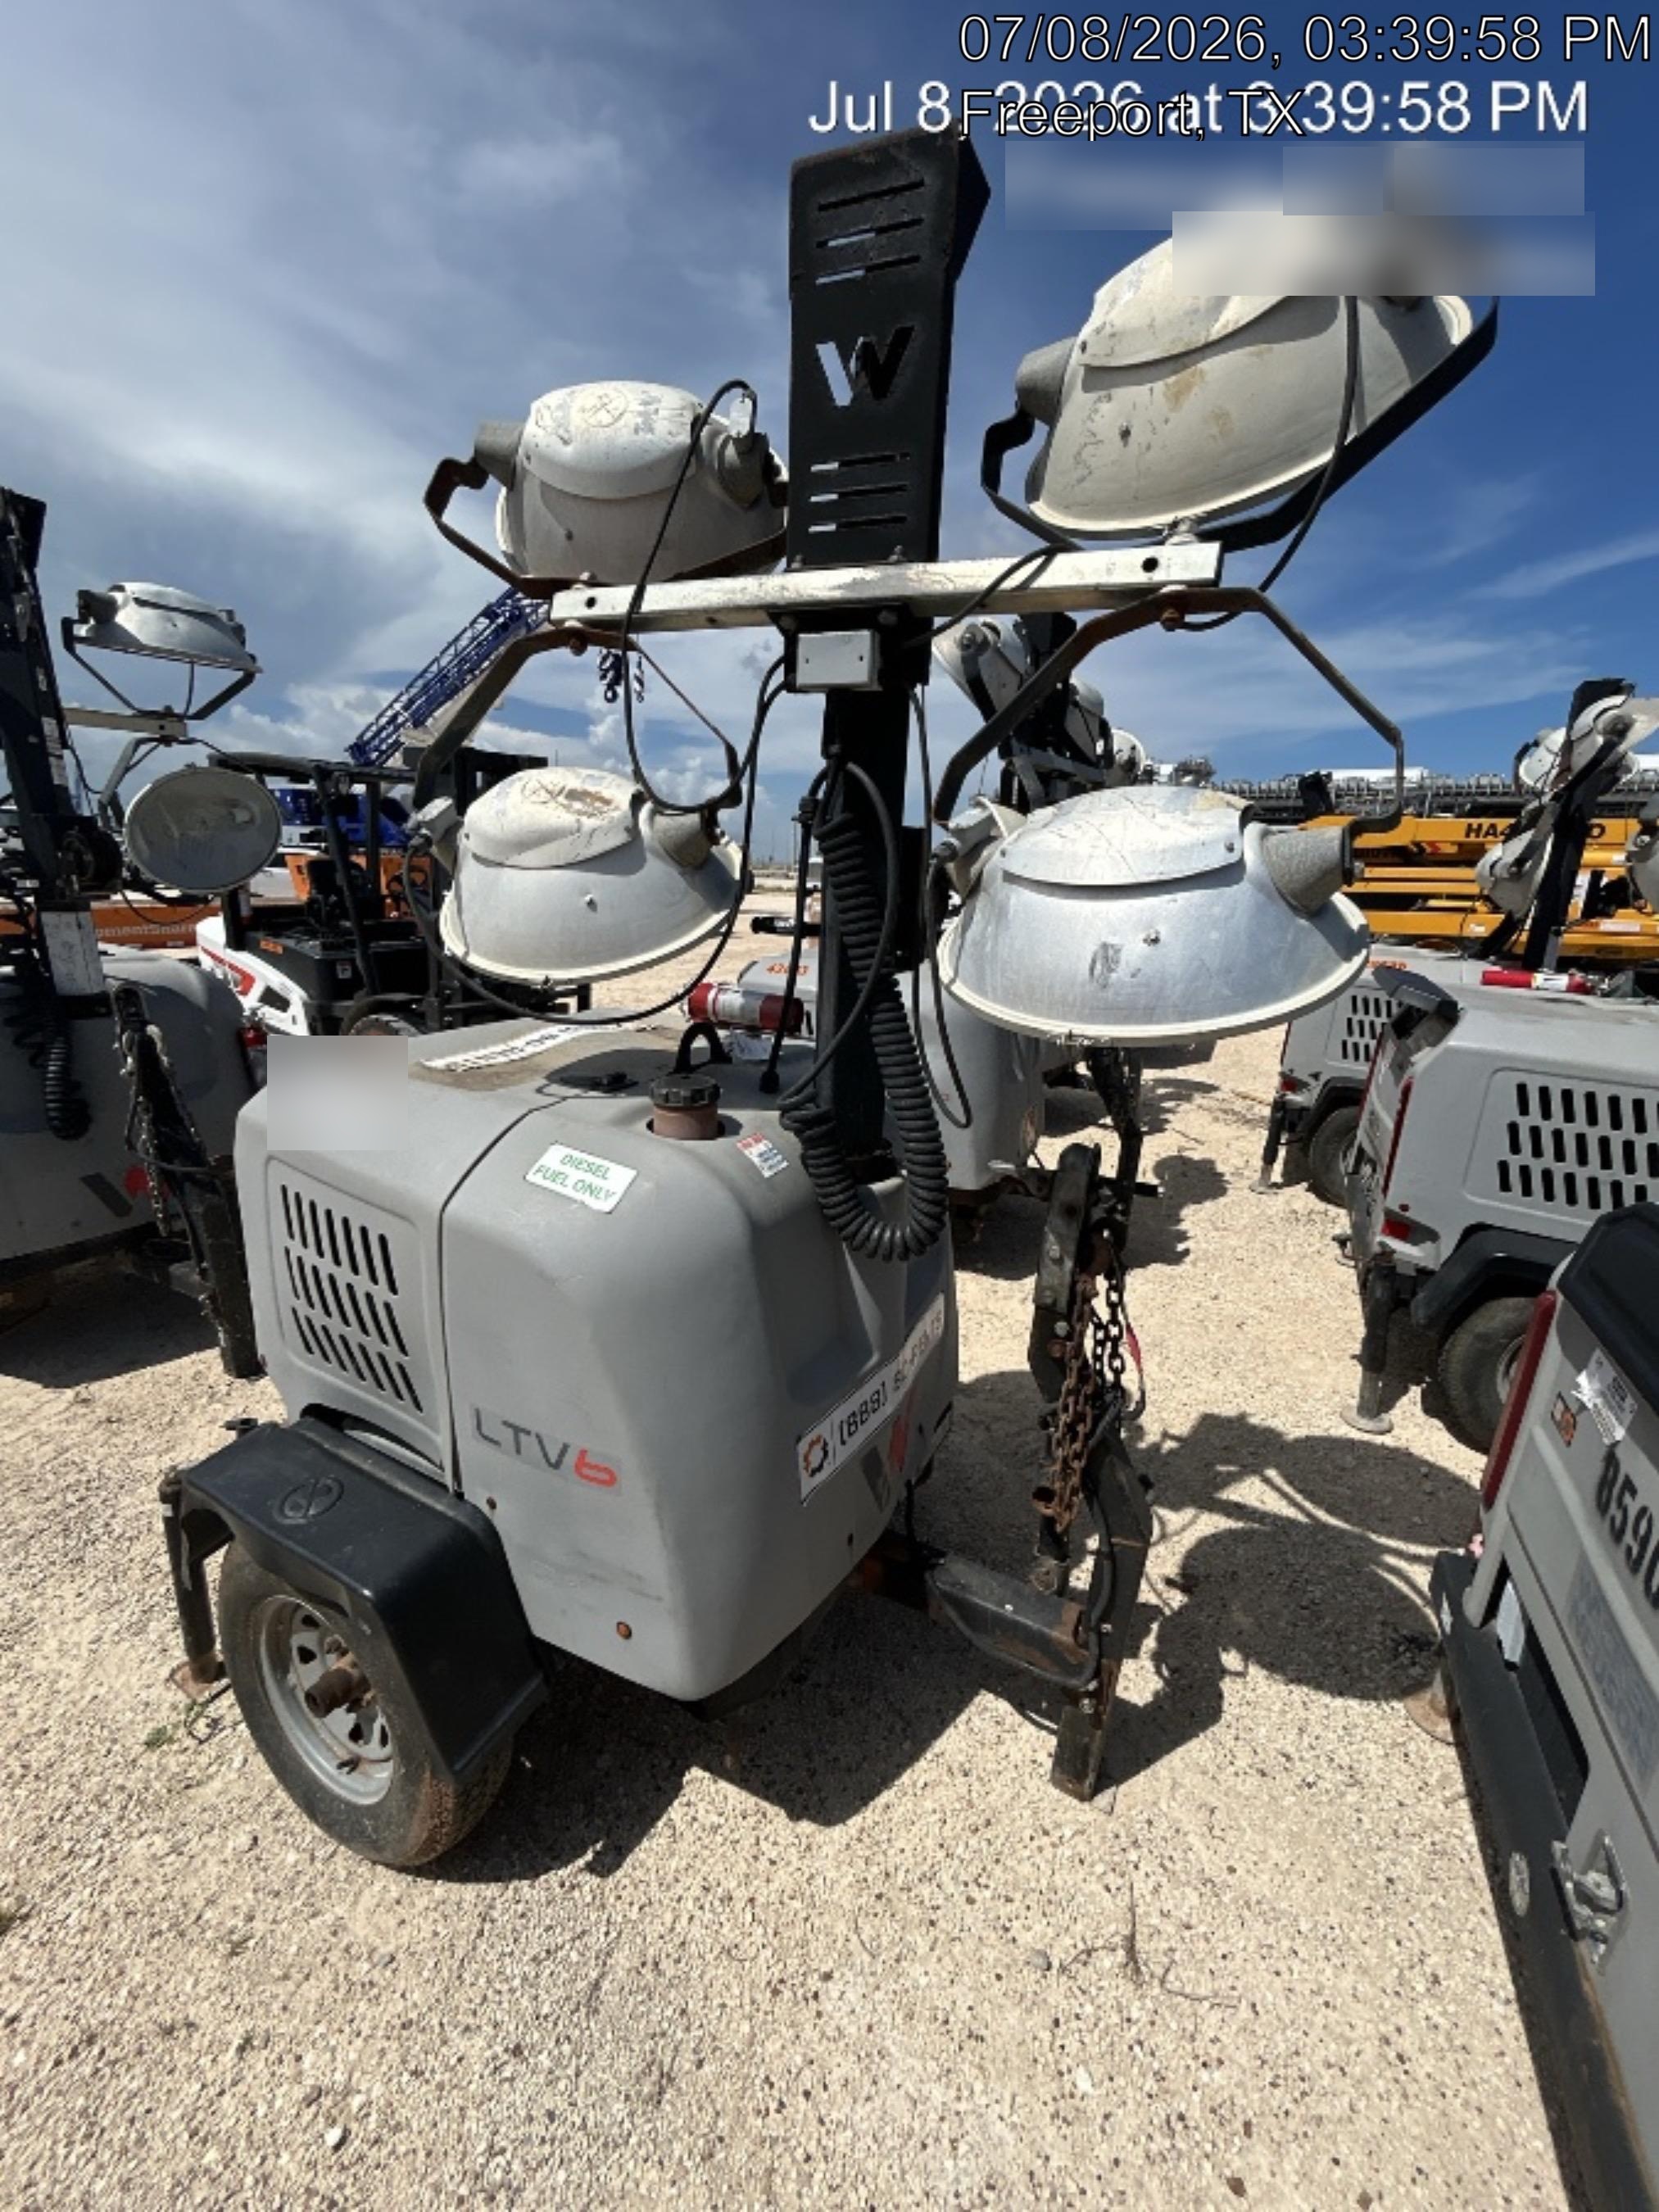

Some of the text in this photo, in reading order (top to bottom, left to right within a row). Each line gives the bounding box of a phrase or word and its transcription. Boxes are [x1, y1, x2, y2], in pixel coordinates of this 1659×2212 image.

[533, 1164, 617, 1201] FUEL ONLY
[560, 1154, 610, 1181] DIESEL
